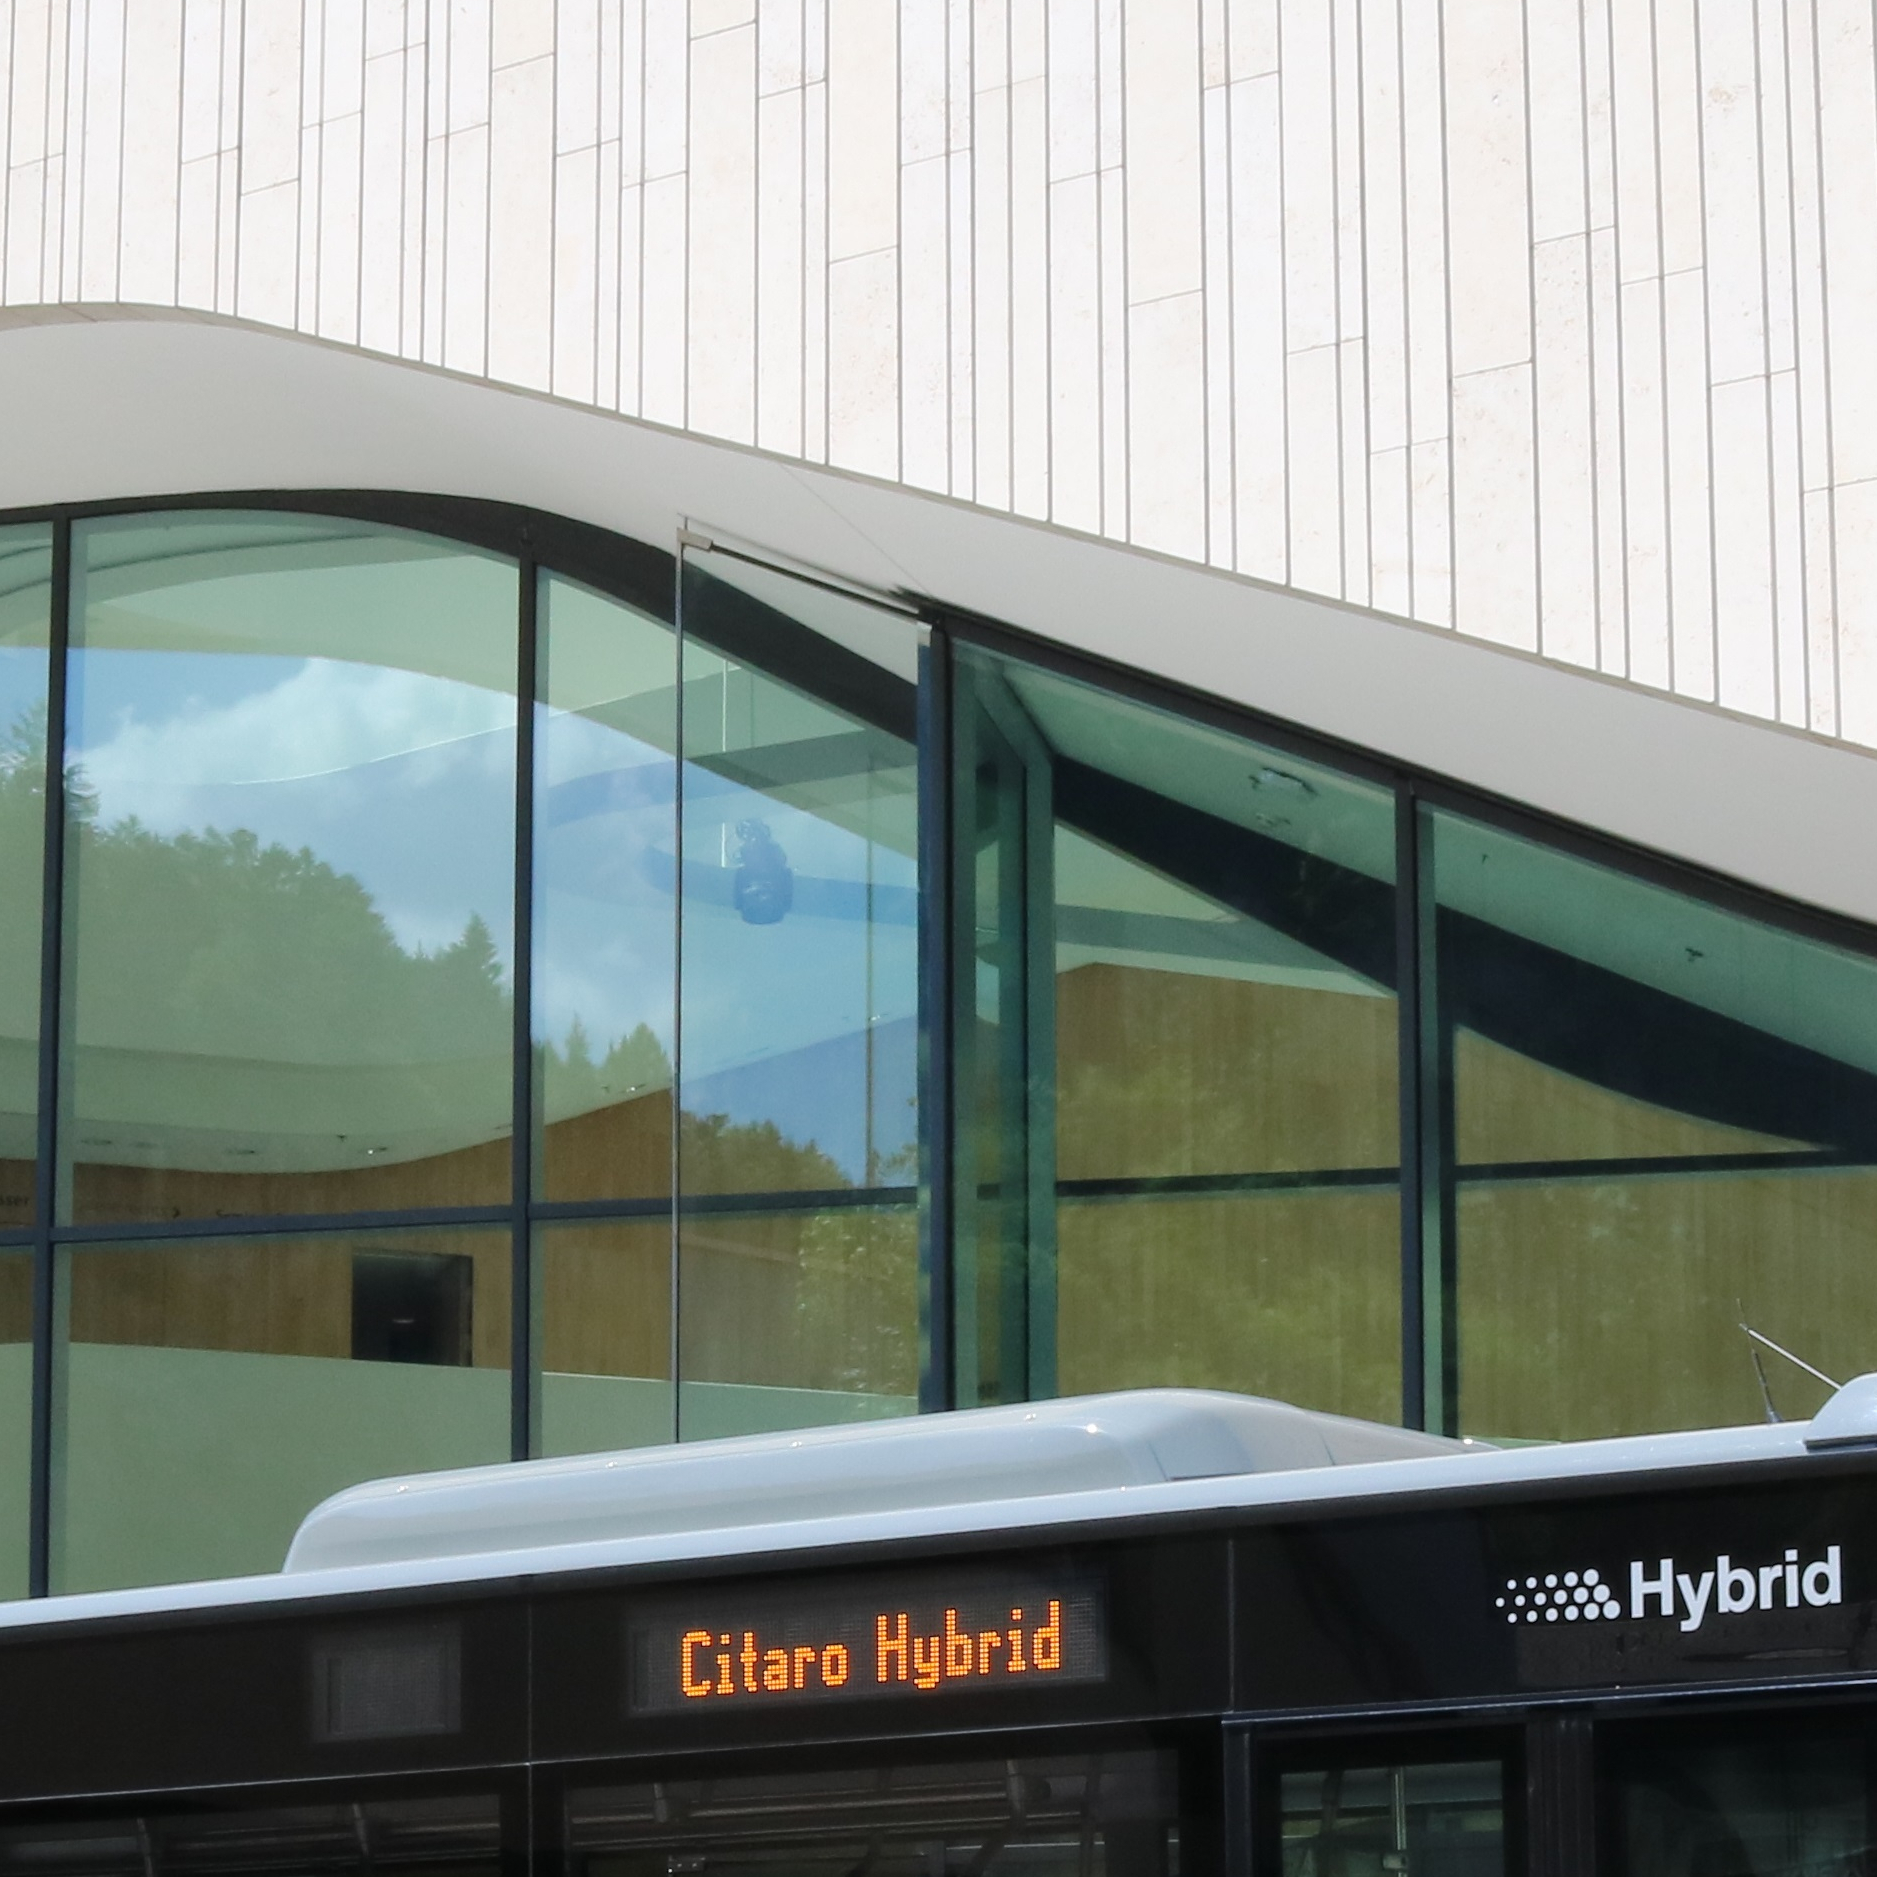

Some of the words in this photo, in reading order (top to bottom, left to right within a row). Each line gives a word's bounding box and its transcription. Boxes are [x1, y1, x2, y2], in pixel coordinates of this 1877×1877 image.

[1629, 1545, 1844, 1632] Hybrid
[680, 1628, 849, 1698] Citaro
[875, 1599, 1061, 1691] Hybrid
